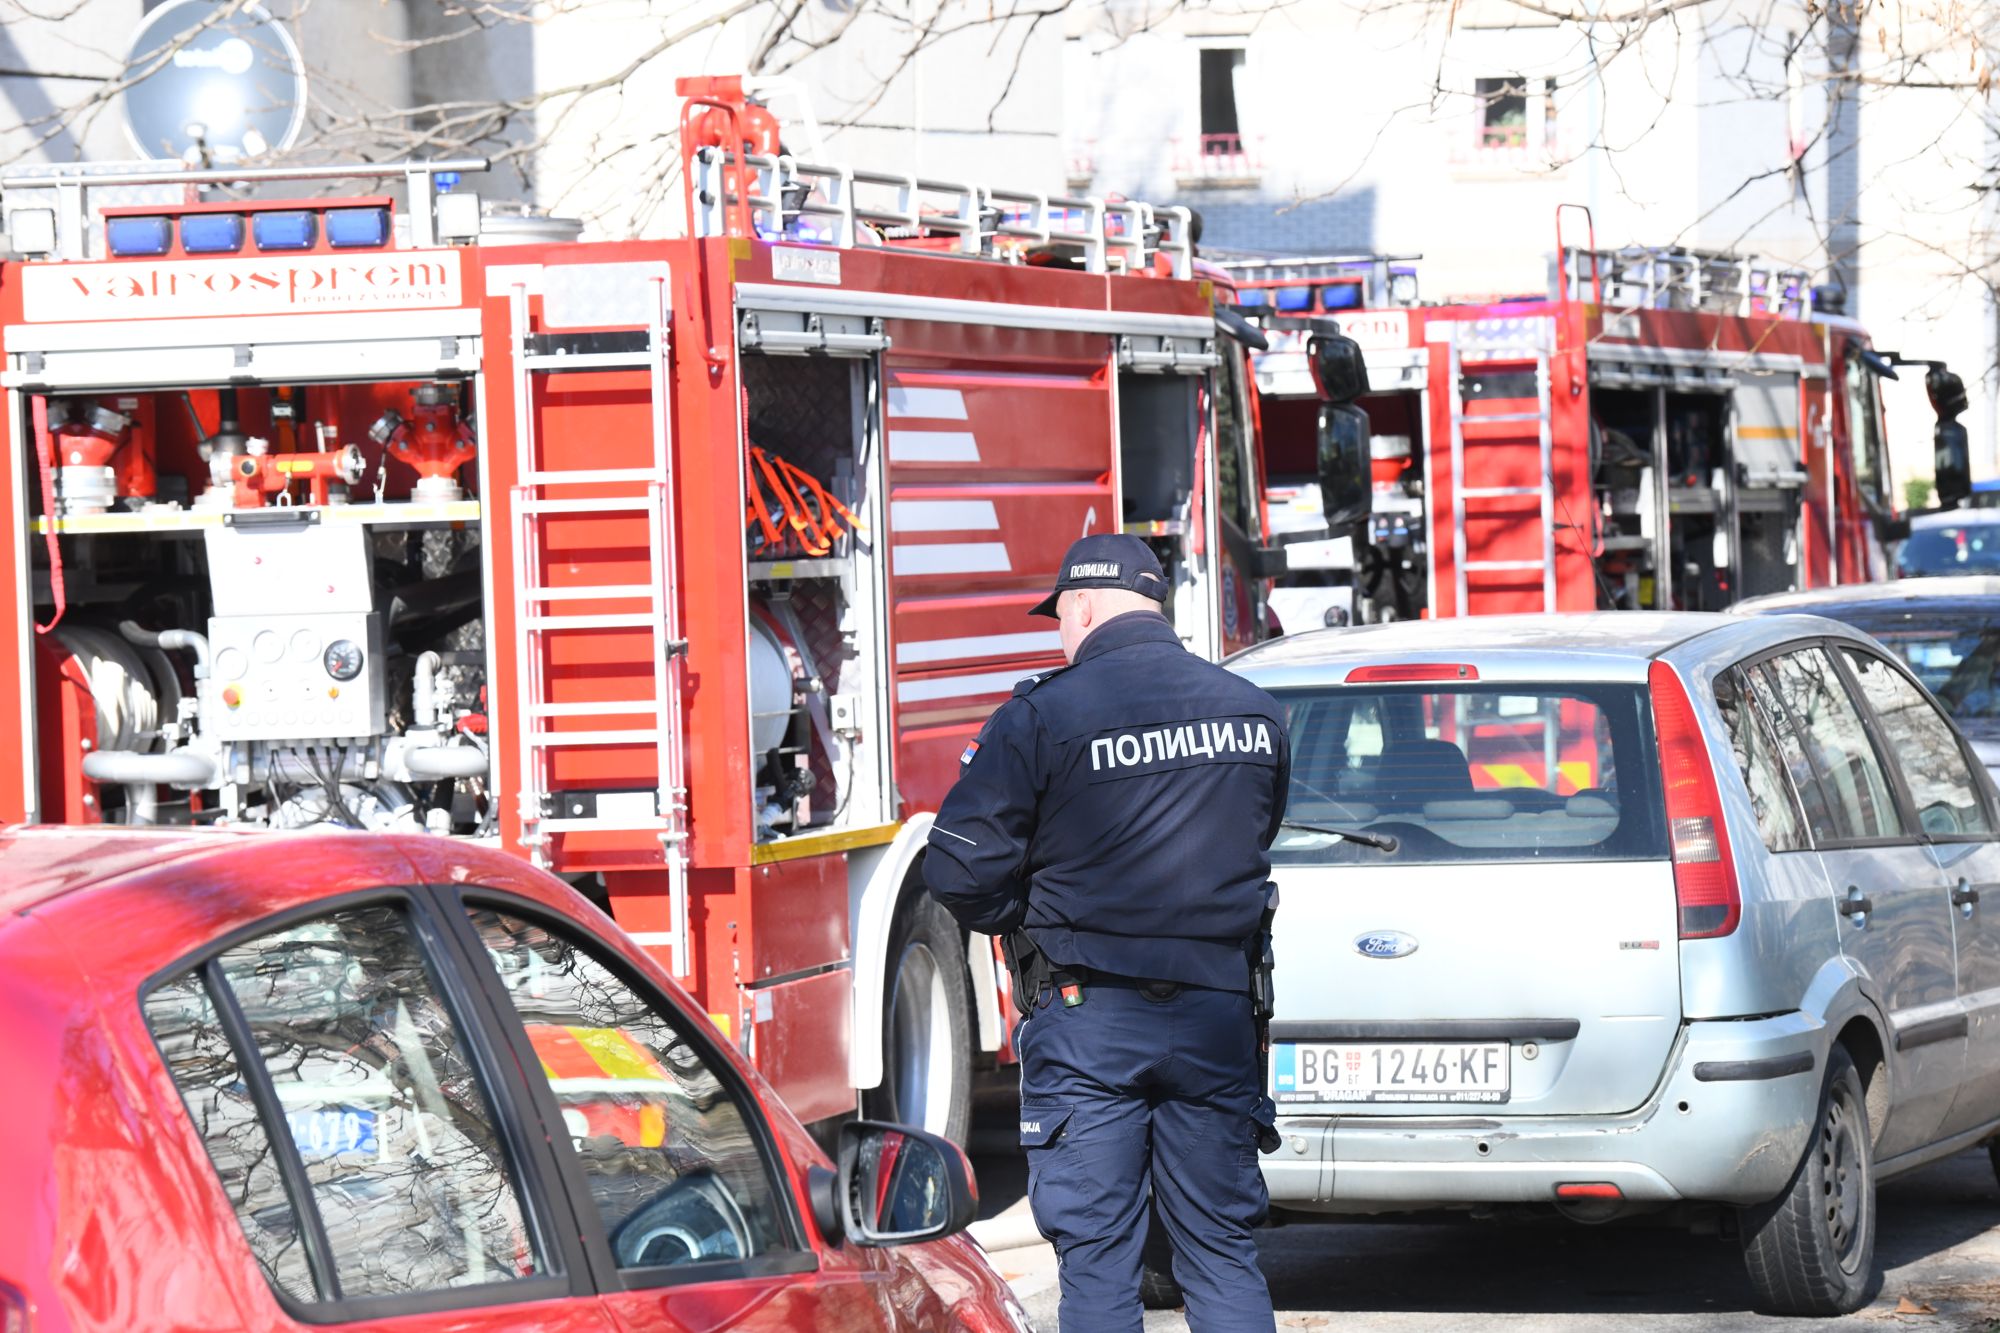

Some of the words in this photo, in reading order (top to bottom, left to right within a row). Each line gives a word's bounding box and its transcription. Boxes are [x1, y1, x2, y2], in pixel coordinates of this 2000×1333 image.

[1070, 563, 1119, 578] ПОЛИЦИЈА
[1091, 722, 1272, 771] ПОЛИЦИЈА
[1302, 1049, 1339, 1085] BG
